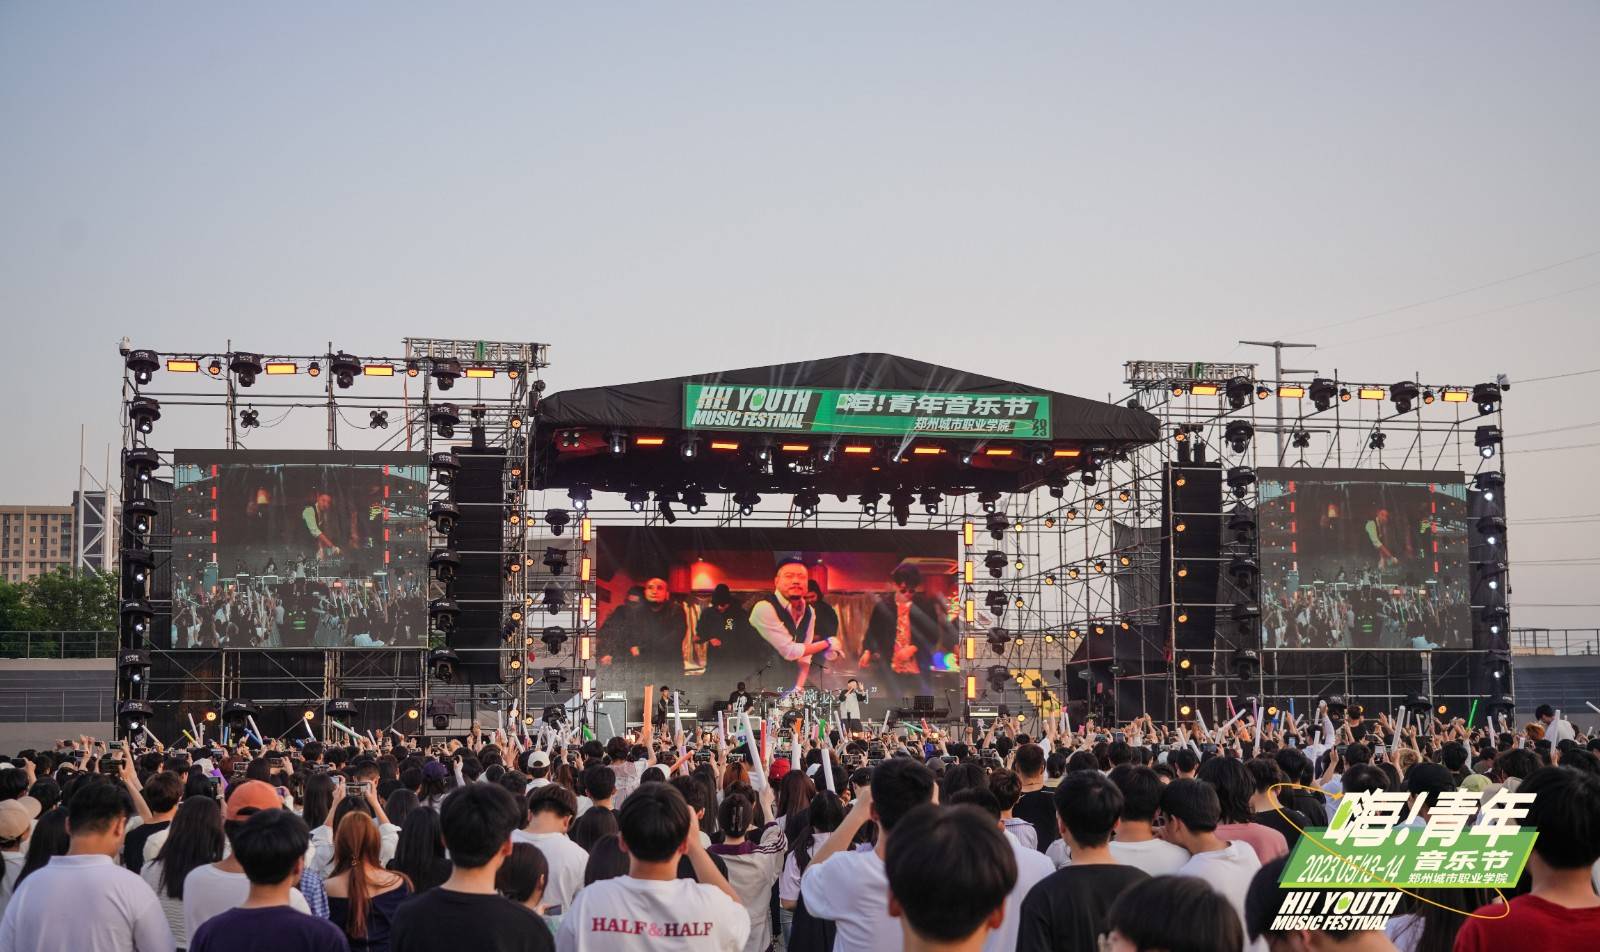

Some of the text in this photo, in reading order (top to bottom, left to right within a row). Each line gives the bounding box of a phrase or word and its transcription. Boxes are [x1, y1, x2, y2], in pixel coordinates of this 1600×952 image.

[696, 386, 813, 413] HI! YOUTH
[836, 393, 1033, 416] 嗨!青年音乐节
[691, 409, 805, 429] MUSIC FESTIVAL
[914, 416, 1010, 432] 郑州城市职业学院
